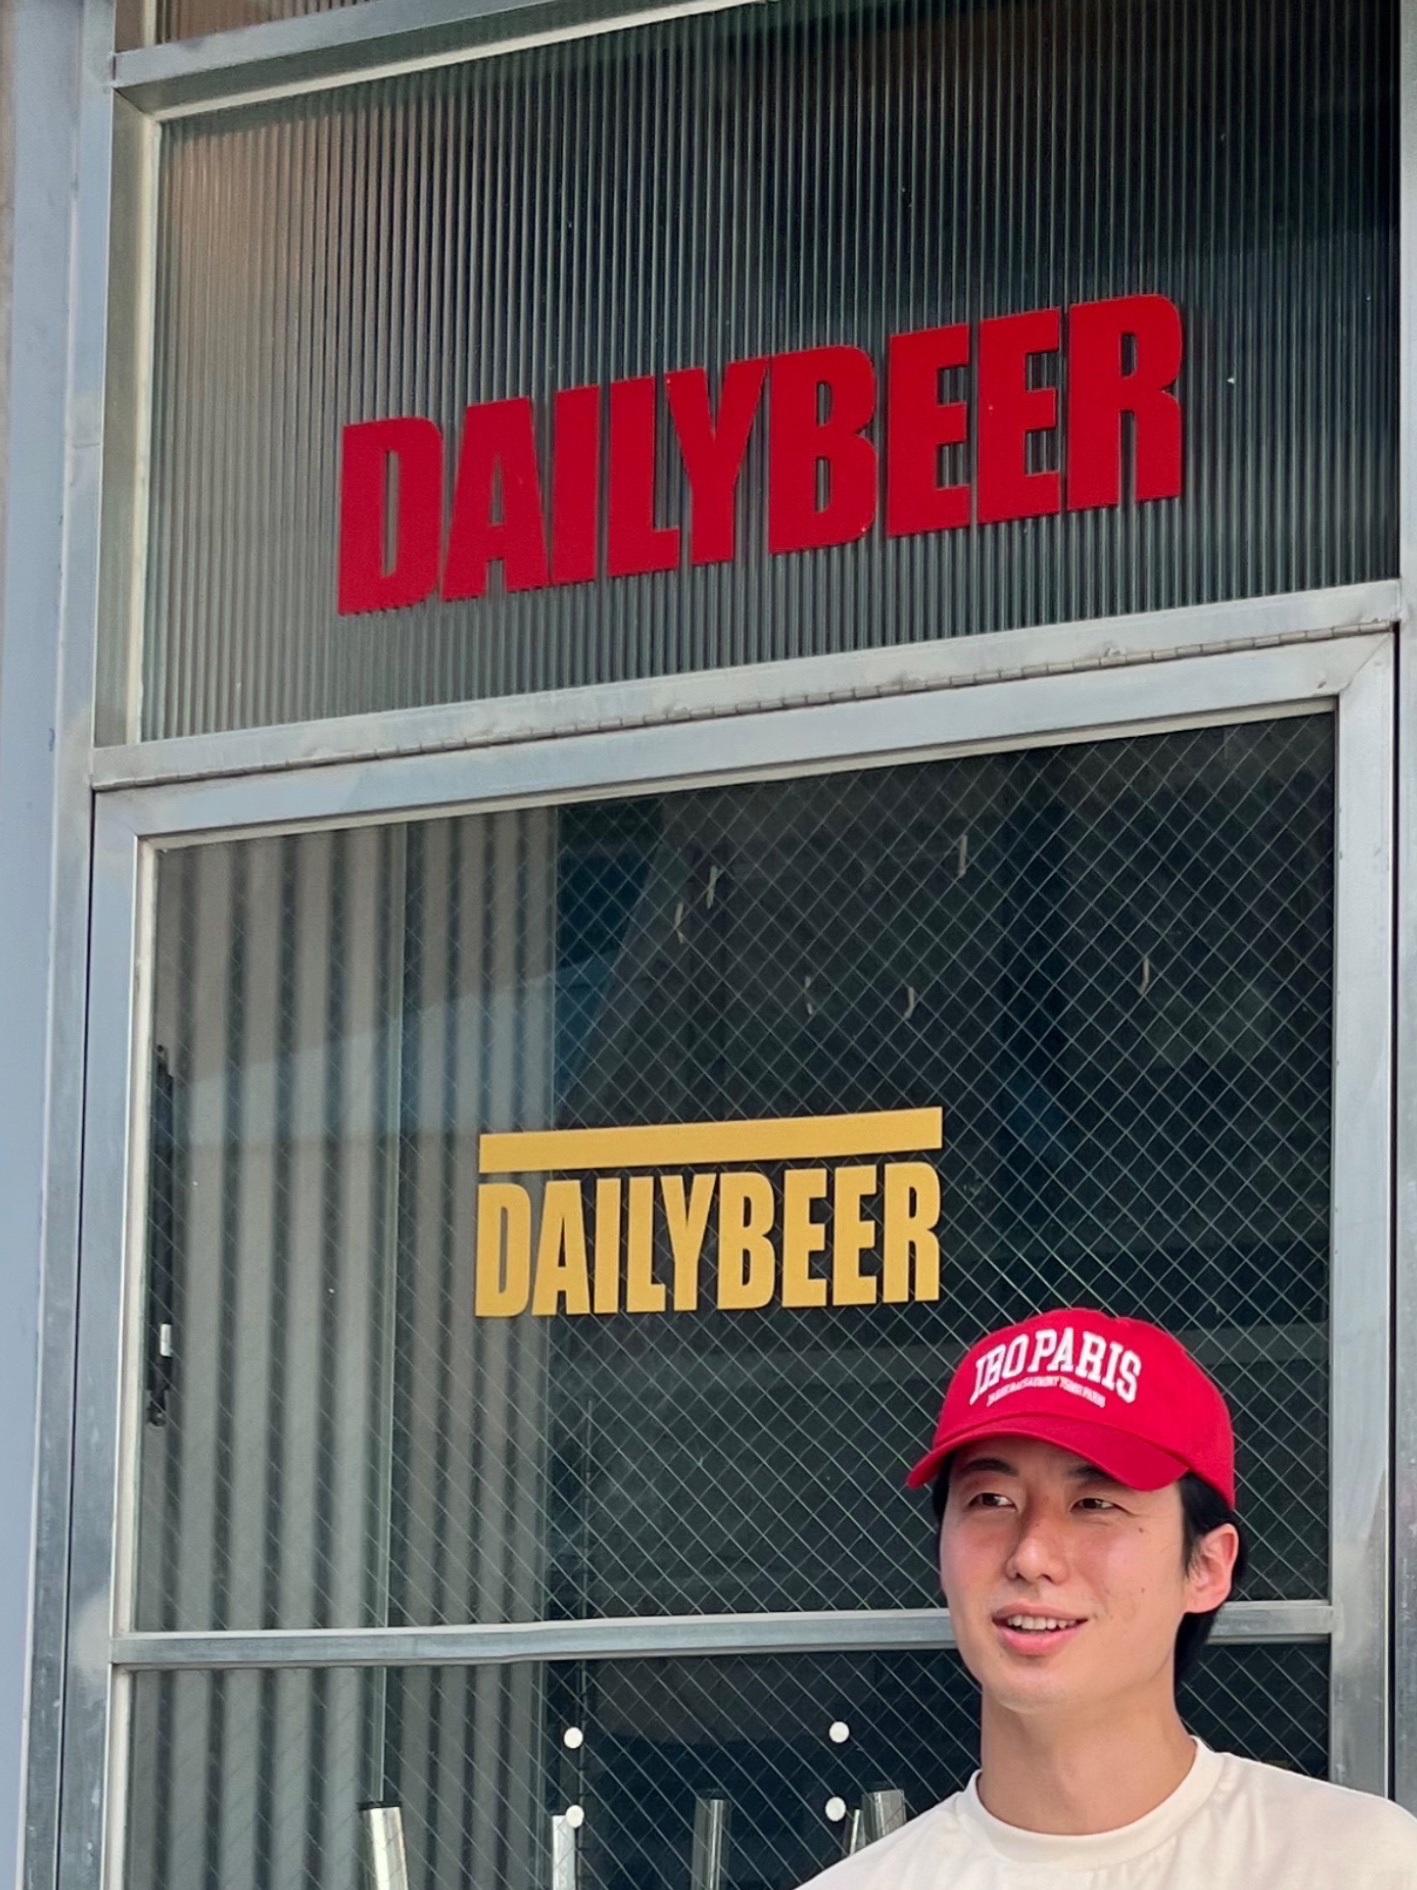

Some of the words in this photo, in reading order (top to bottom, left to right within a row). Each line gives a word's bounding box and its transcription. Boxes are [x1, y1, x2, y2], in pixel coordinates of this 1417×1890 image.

[338, 294, 1183, 615] DAILYBEER
[475, 1161, 941, 1317] DAILYBEER
[1027, 1326, 1142, 1404] PARIS
